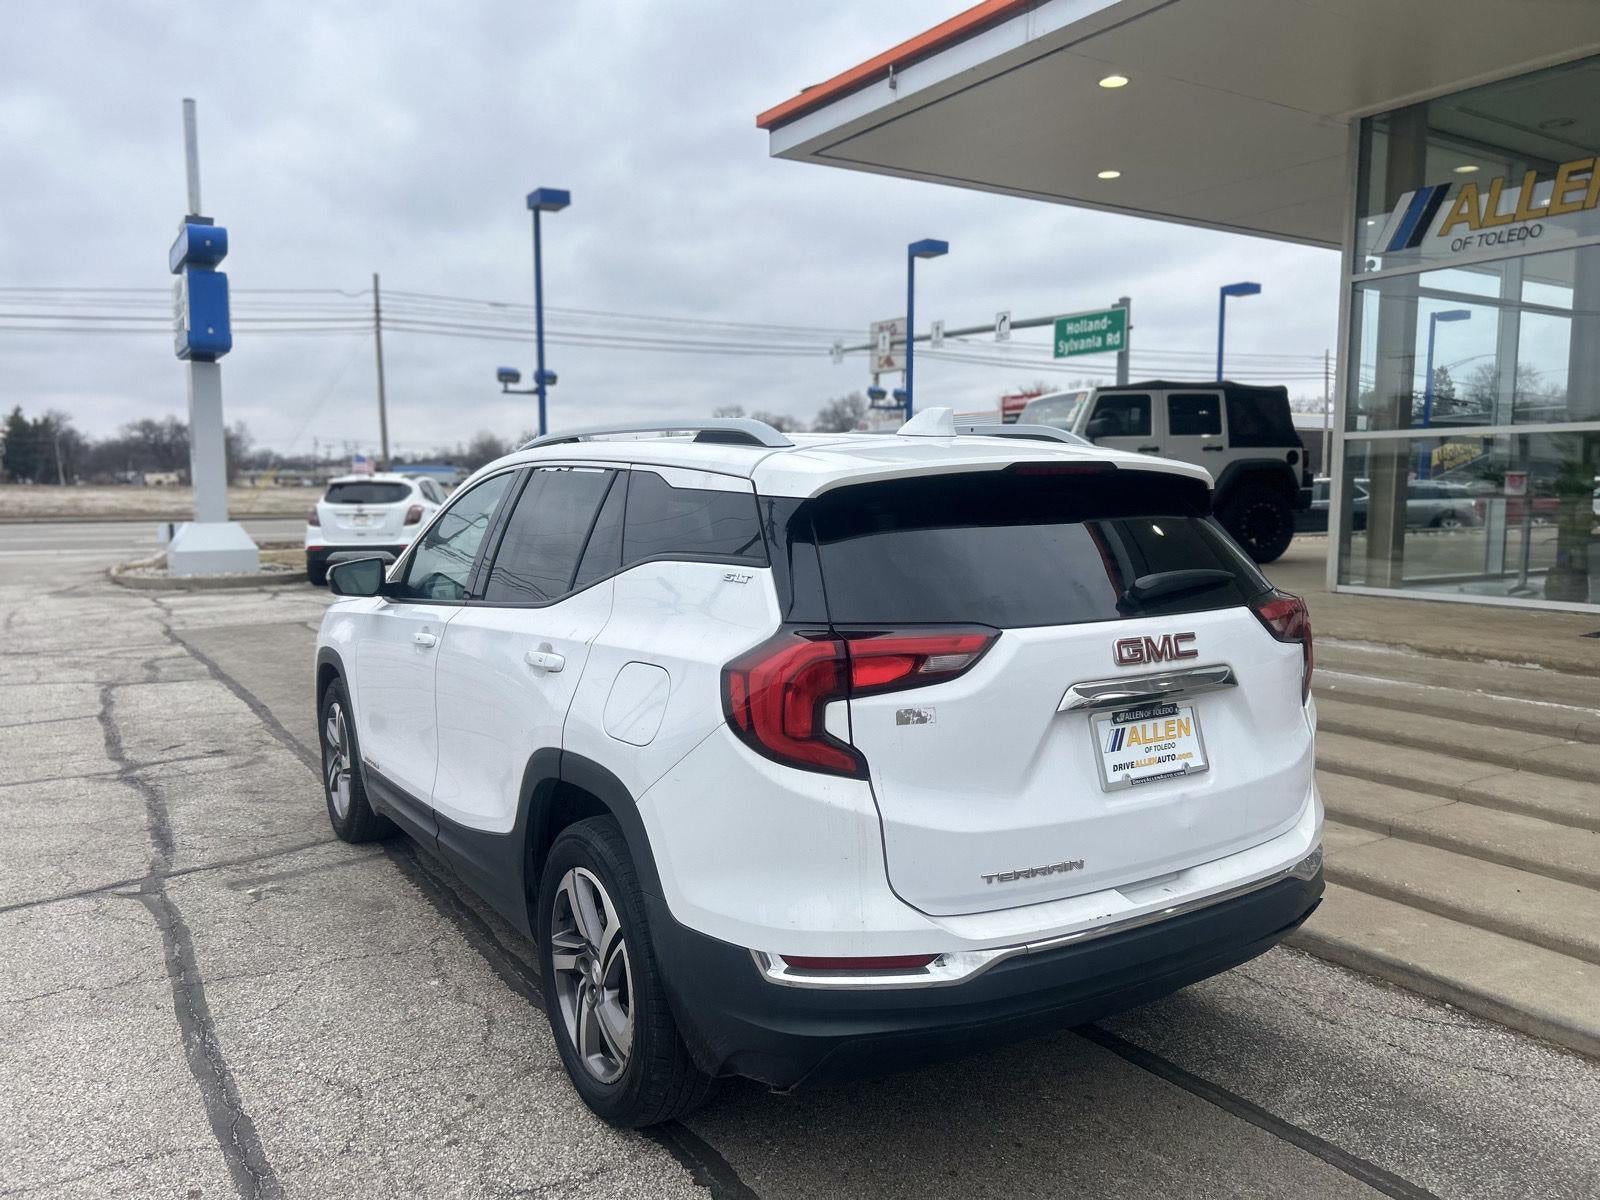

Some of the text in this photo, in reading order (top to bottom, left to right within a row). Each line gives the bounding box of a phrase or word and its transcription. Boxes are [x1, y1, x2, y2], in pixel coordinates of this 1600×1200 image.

[1451, 223, 1544, 252] OF TOLEDO
[1066, 315, 1112, 335] Holland-
[1058, 331, 1121, 355] Sylvania Rd
[723, 573, 754, 584] SLT
[1112, 631, 1199, 667] GMC
[1124, 710, 1144, 720] ALLEN
[1152, 706, 1174, 716] TOLEDO
[1126, 717, 1191, 747] ALLEN
[1144, 742, 1176, 754] OF TOLEDO
[980, 858, 1085, 884] TERRAIN
